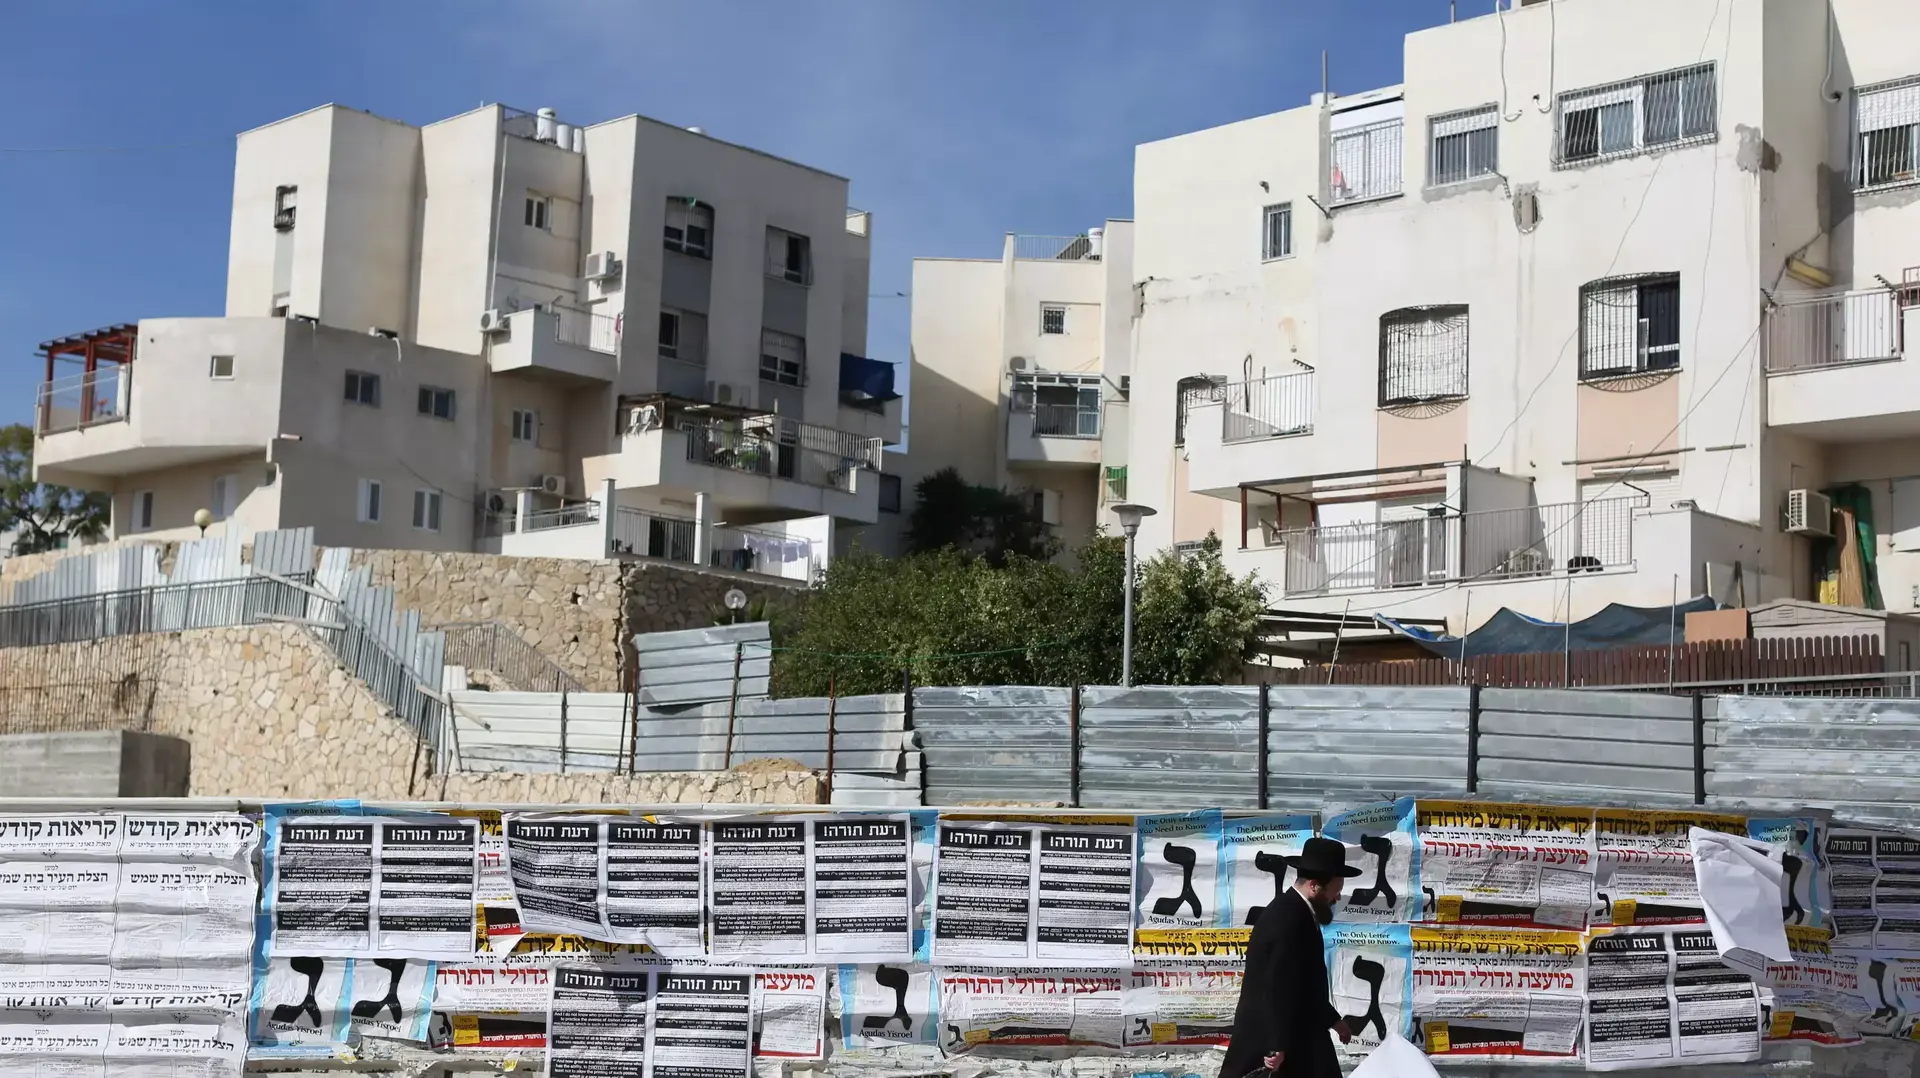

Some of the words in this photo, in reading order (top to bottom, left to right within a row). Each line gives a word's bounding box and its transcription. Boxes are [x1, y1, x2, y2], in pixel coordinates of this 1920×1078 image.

[1357, 808, 1373, 818] Only
[1374, 806, 1394, 814] Letter
[1160, 817, 1177, 825] Only
[1351, 817, 1369, 825] Need
[1379, 814, 1402, 822] Know.
[1487, 813, 1531, 836] קודש
[48, 820, 116, 839] קריאות
[129, 821, 179, 840] קודש
[185, 821, 254, 840] קריאות
[516, 826, 554, 837] תורה!
[561, 827, 590, 837] דעת
[617, 827, 656, 839] תורה!
[662, 828, 691, 839] דעת
[723, 828, 762, 838] תורה!
[768, 827, 796, 838] דעת
[824, 826, 862, 837] תורה!
[869, 825, 897, 836] דעת
[1139, 827, 1154, 835] You
[1155, 825, 1174, 833] Need
[1185, 823, 1208, 831] Know.
[1236, 826, 1250, 834] The
[1252, 824, 1268, 832] Only
[1270, 822, 1292, 831] Letter
[290, 829, 329, 840] תורה!
[335, 829, 364, 840] דעת
[392, 830, 431, 841] תורה!
[437, 830, 466, 841] דעת
[950, 832, 988, 845] תורה!
[1230, 835, 1245, 843] You
[1247, 834, 1266, 842] Need
[1276, 831, 1300, 840] Know.
[1423, 831, 1444, 839] חברי
[1447, 831, 1469, 840] ורבנן
[1472, 832, 1491, 842] מרנן
[1494, 833, 1510, 842] מאת
[1513, 834, 1549, 843] הבחירות
[994, 835, 1022, 846] דעת
[1050, 836, 1089, 849] תורה!
[1094, 837, 1124, 850] דעת
[1552, 836, 1586, 845] למערכת
[1616, 838, 1636, 847] ורבנן
[1853, 841, 1867, 851] דעת
[1424, 840, 1482, 858] התורה
[1486, 840, 1529, 861] גדולי
[1881, 842, 1901, 851] תורה!
[1904, 842, 1920, 851] דעת
[1533, 846, 1589, 865] מועצת
[24, 874, 44, 882] בית
[47, 873, 73, 883] העיר
[77, 870, 108, 882] הצלת
[131, 874, 158, 883] שמש
[161, 874, 181, 883] בית
[185, 874, 211, 884] העיר
[214, 872, 246, 885] הצלת
[1342, 906, 1368, 914] Agudas
[1370, 906, 1396, 916] Yisroel
[1148, 916, 1175, 925] Agudas
[1176, 917, 1203, 928] Yisroel
[1351, 931, 1368, 939] Only
[1516, 933, 1542, 941] לעשות
[1632, 938, 1657, 948] דעת
[1681, 937, 1715, 947] תורה!
[1475, 941, 1520, 958] קודש
[1457, 957, 1477, 966] מרנן
[1479, 958, 1498, 966] מאת
[1500, 958, 1536, 967] הבחירות
[1539, 960, 1573, 968] למערכת
[500, 963, 548, 985] גדולי
[944, 965, 967, 973] חברי
[996, 966, 1017, 974] מרנן
[1019, 966, 1040, 974] מאת
[565, 973, 604, 987] תורה!
[1132, 971, 1192, 987] התורה
[1470, 965, 1513, 988] גדולי
[1518, 972, 1573, 990] מועצת
[19, 981, 45, 989] הזקנים
[47, 980, 55, 989] מן
[75, 979, 97, 987] הנוטל
[100, 979, 108, 987] כל
[113, 981, 136, 990] נכשל!
[137, 982, 152, 990] אינו
[609, 977, 638, 988] דעת
[667, 978, 706, 990] תורה!
[712, 979, 741, 991] דעת
[944, 978, 1003, 994] התורה
[1008, 973, 1057, 994] גדולי
[1062, 978, 1121, 994] מועצת
[266, 1021, 294, 1032] Agudas
[296, 1024, 322, 1036] Yisroel
[376, 1019, 401, 1032] Yisroel
[1133, 1017, 1150, 1035] ג
[482, 1034, 503, 1042] למערכה
[859, 1029, 886, 1038] Agudas
[887, 1030, 913, 1039] Yisroel
[13, 1037, 34, 1046] בית
[37, 1038, 64, 1047] העיר
[66, 1035, 98, 1047] הצלת
[118, 1038, 146, 1046] שמש
[148, 1038, 169, 1047] בית
[173, 1039, 200, 1048] העיר
[203, 1036, 234, 1051] הצלת
